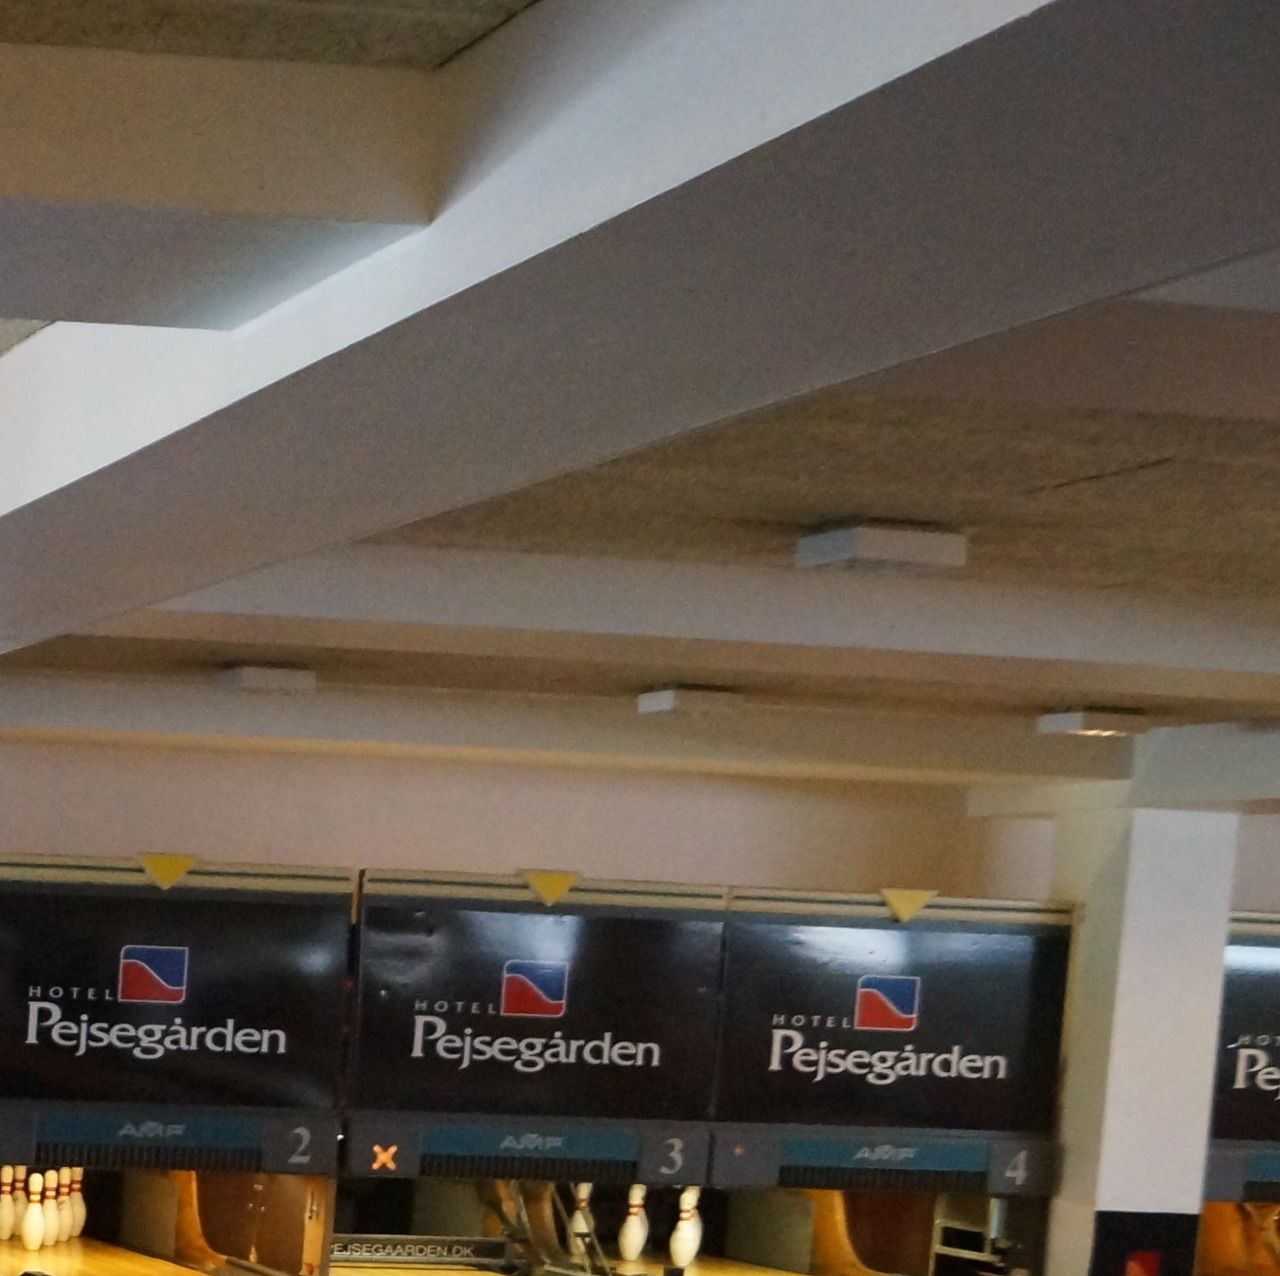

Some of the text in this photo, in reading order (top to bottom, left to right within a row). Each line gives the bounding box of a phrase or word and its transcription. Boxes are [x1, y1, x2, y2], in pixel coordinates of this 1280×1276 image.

[28, 985, 114, 1001] HOTEL
[413, 1000, 497, 1015] HOTEL
[25, 1001, 287, 1060] Pejsegården
[771, 1013, 851, 1029] HOTEL
[410, 1014, 661, 1073] Pejsegården
[768, 1028, 1008, 1085] Pejsegården
[287, 1126, 312, 1165] 2
[659, 1137, 684, 1175] 3
[1004, 1150, 1029, 1187] 4
